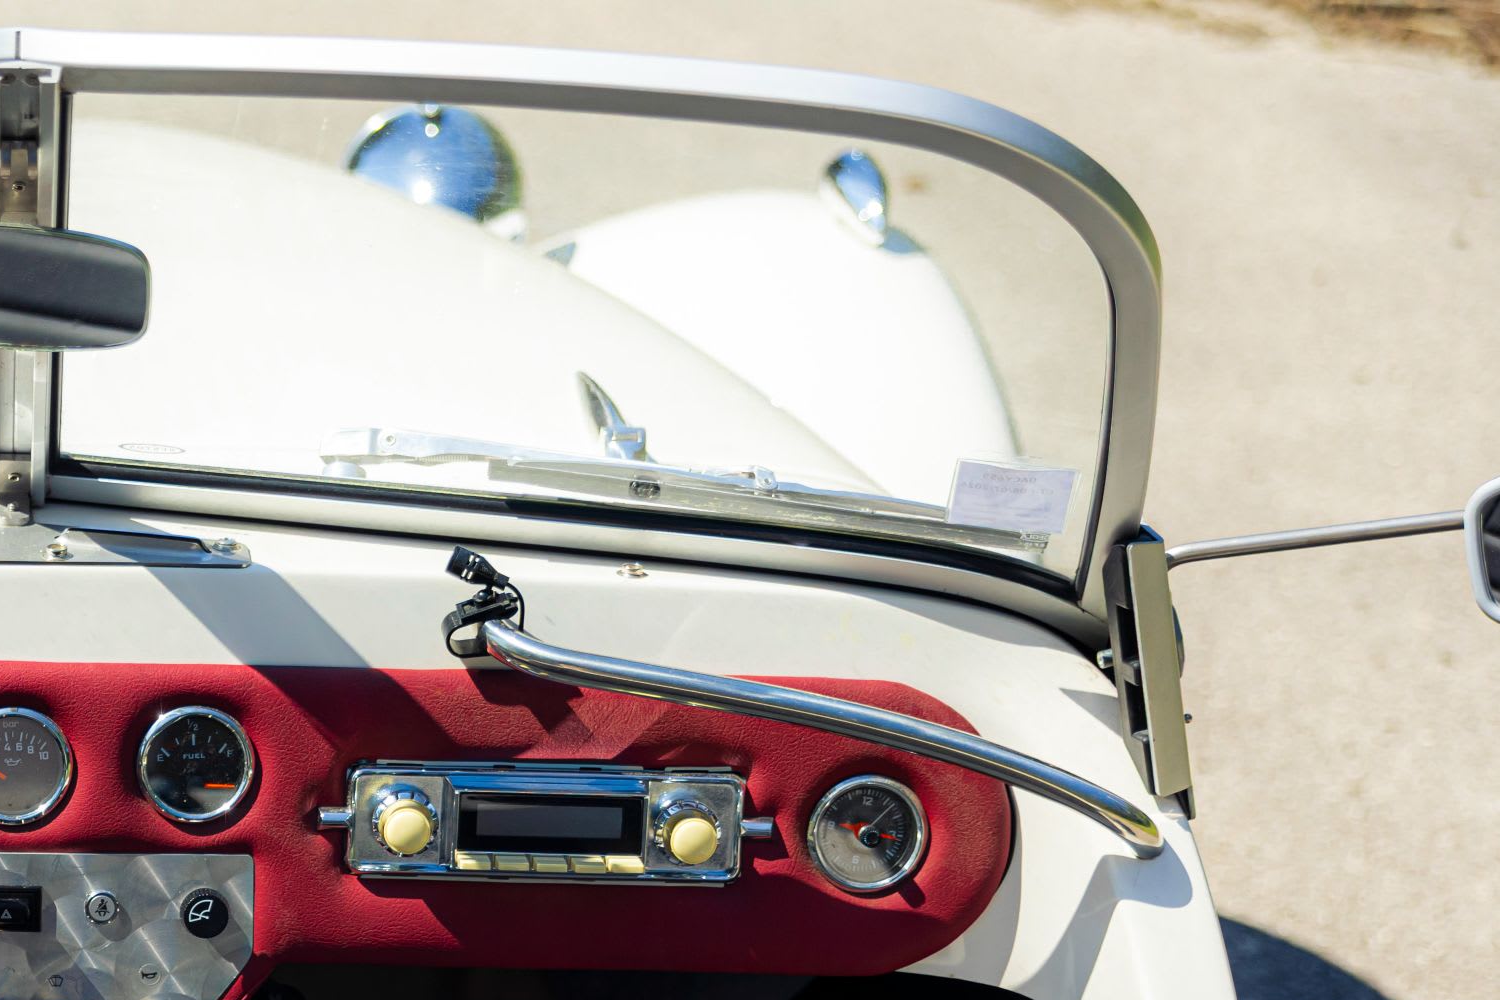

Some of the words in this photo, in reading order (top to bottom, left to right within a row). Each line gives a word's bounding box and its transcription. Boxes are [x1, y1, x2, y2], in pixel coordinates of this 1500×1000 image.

[4, 743, 11, 751] 4
[16, 743, 22, 751] 6
[27, 746, 34, 754] 8
[39, 752, 48, 760] 10
[862, 796, 873, 806] 12
[852, 855, 859, 864] 6
